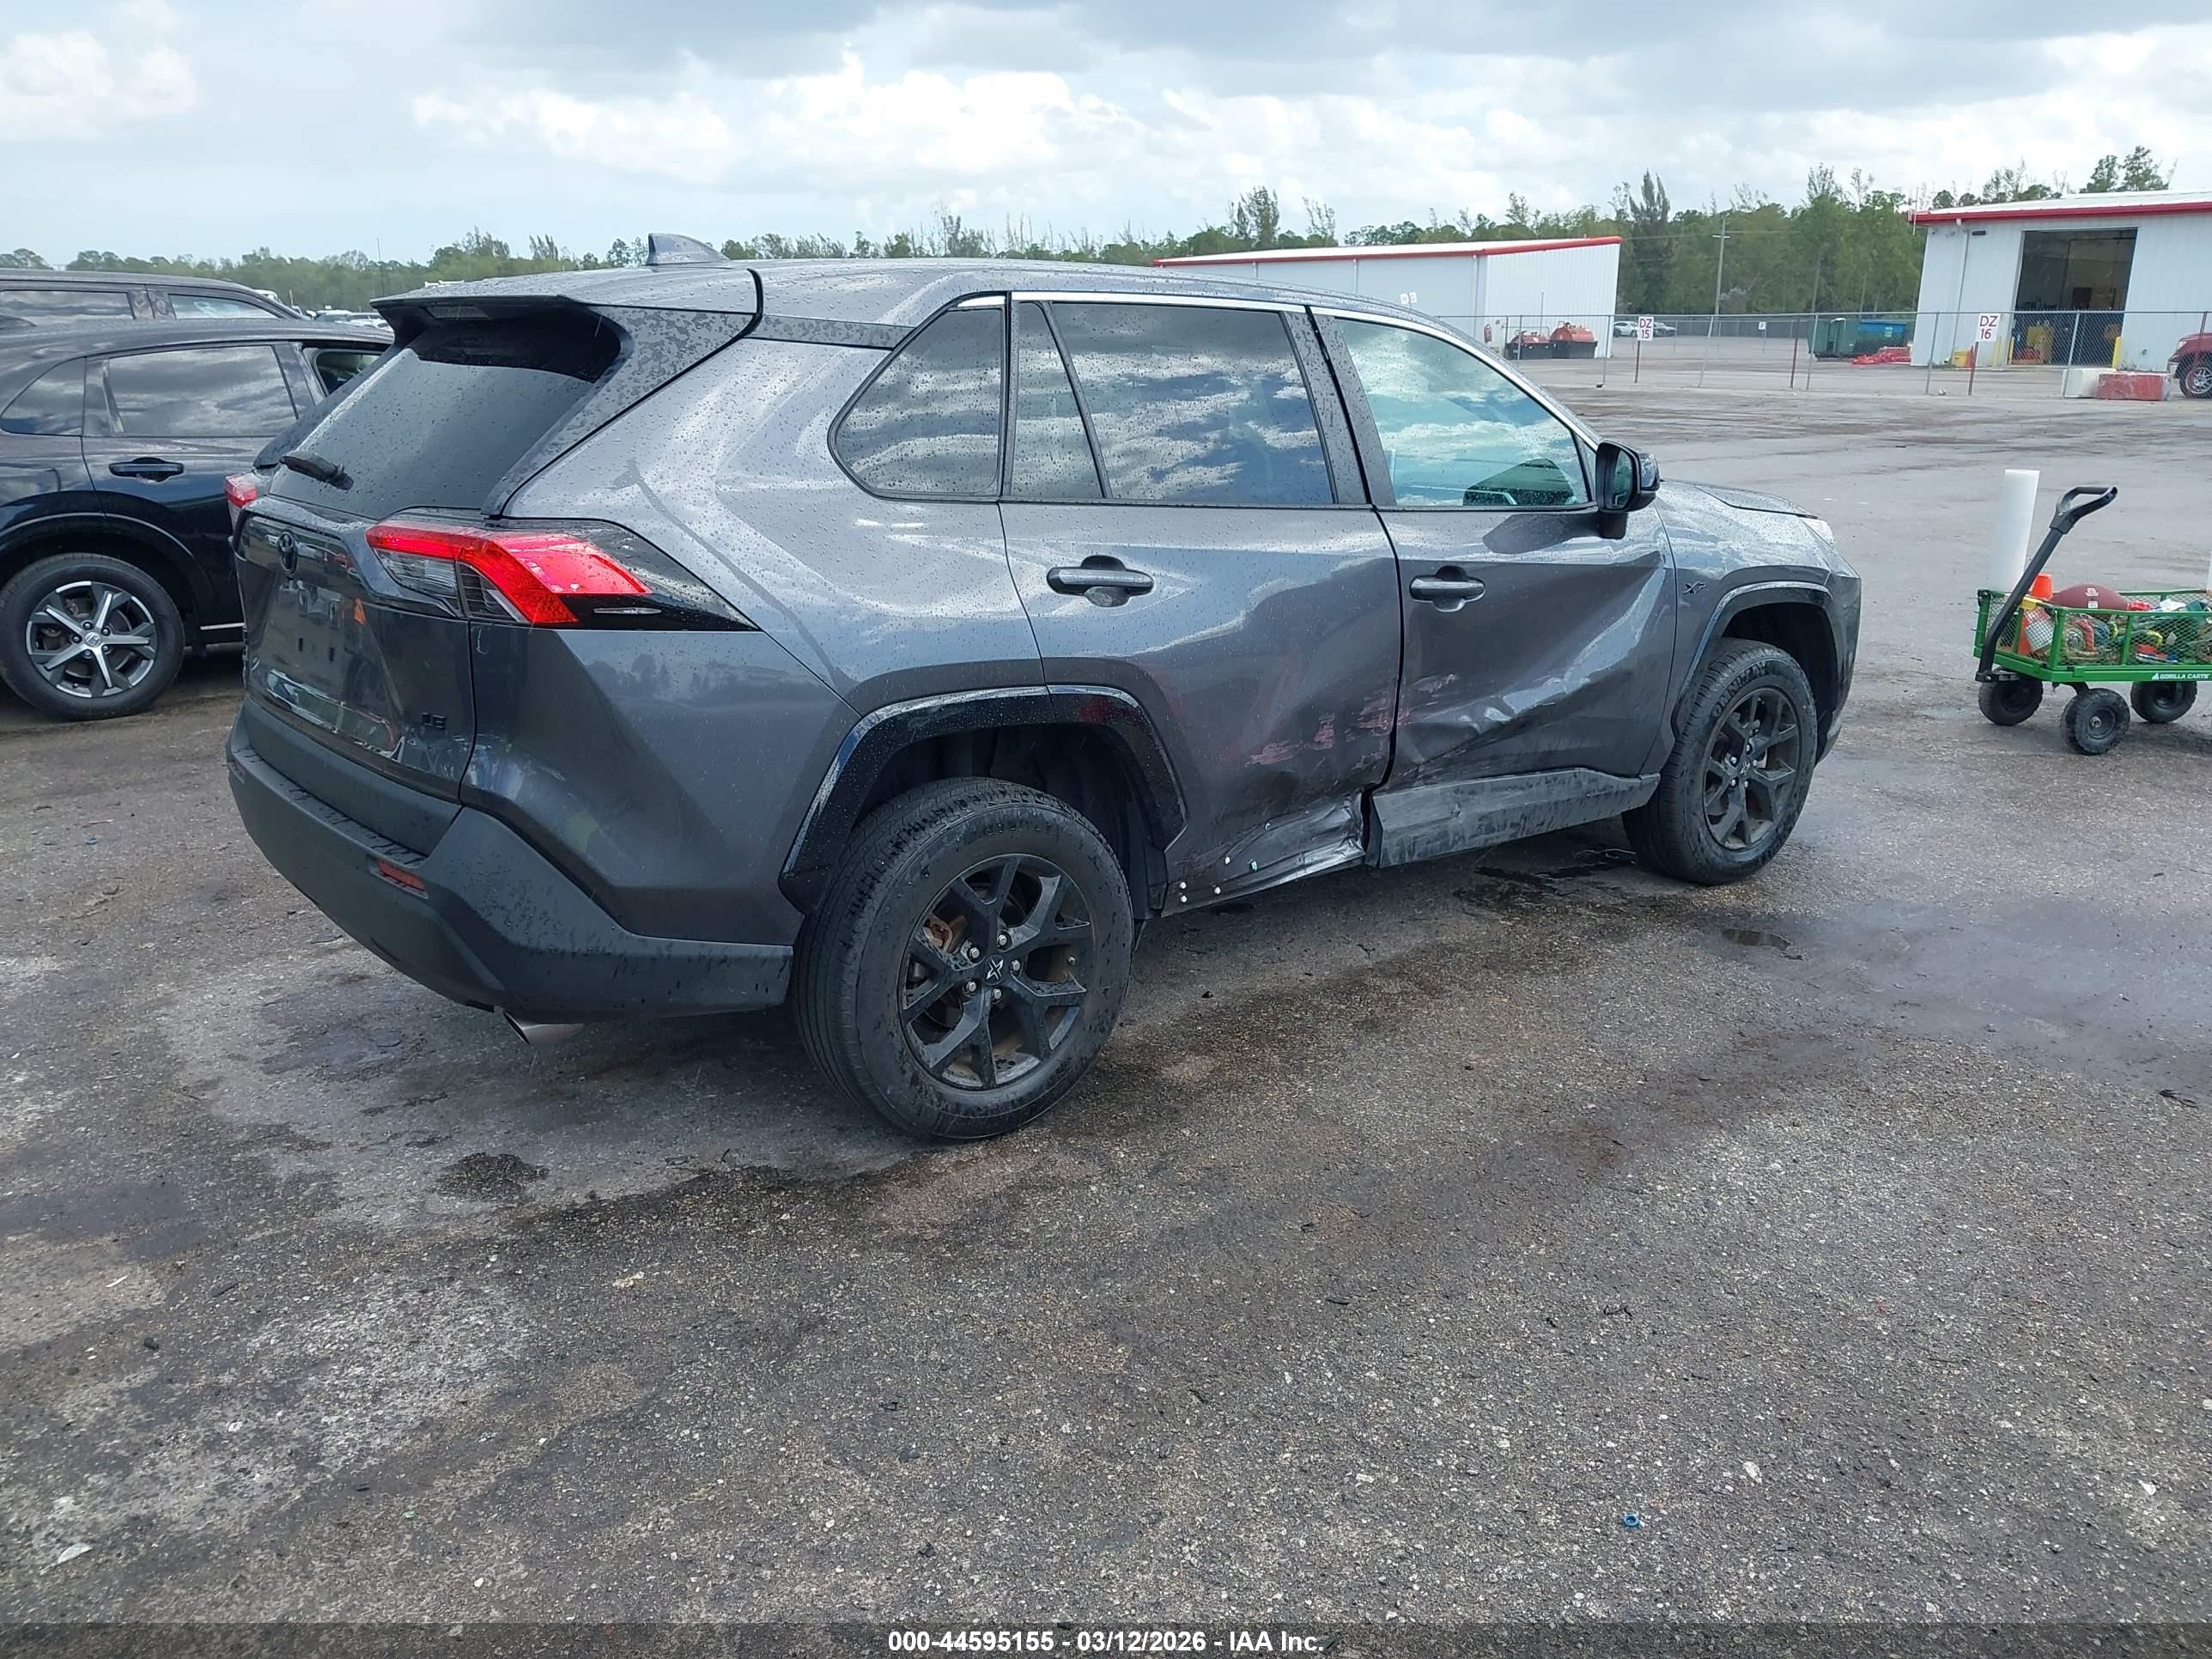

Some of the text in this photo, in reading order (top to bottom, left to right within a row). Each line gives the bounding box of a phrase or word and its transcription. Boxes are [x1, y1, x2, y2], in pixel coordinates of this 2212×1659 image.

[1640, 318, 1653, 329] DZ
[1979, 315, 1998, 327] DZ
[1641, 329, 1650, 339] 15
[1980, 328, 1992, 339] 16
